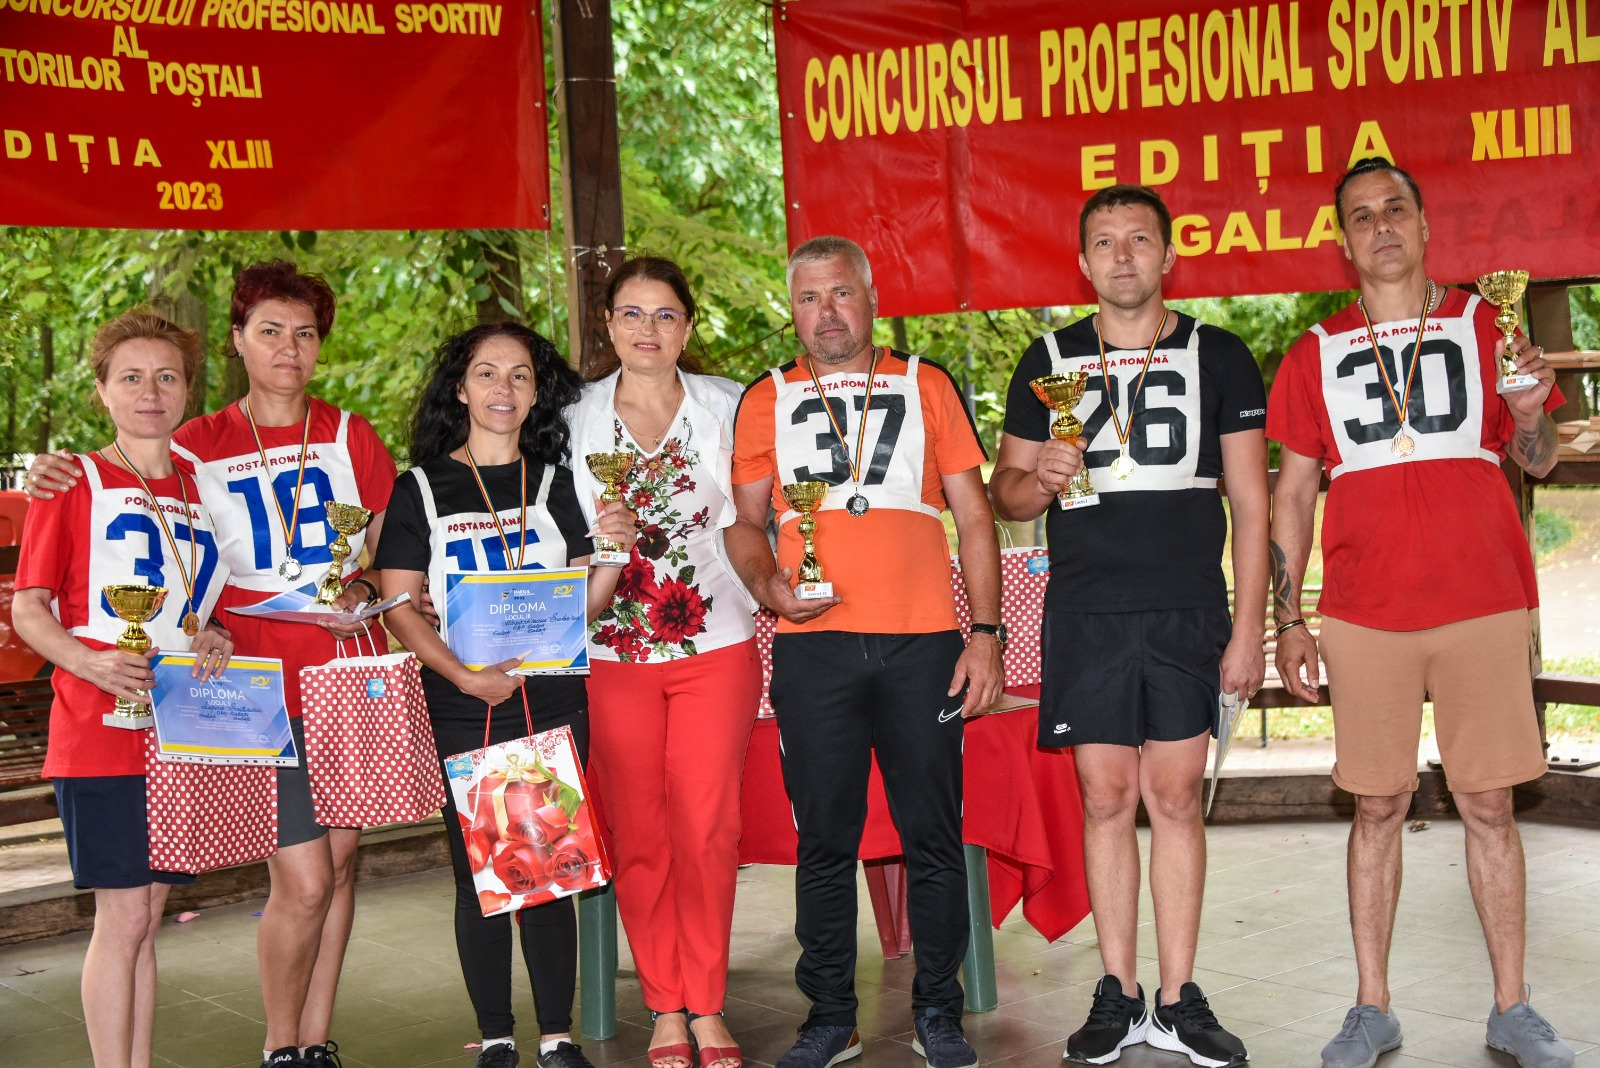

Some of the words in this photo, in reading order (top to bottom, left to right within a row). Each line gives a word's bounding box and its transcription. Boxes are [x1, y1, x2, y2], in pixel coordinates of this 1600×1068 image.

[201, 0, 386, 34] PROFESIONAL
[396, 3, 502, 36] SPORTIV
[112, 25, 149, 59] AL
[0, 48, 125, 92] TORILOR
[804, 35, 1022, 143] CONCURSUL
[1040, 1, 1313, 118] PROFESIONAL
[1328, 0, 1512, 90] SPORTIV
[1543, 0, 1600, 67] AL
[1471, 104, 1572, 161] XLIII
[206, 140, 273, 169] XLIII
[157, 181, 223, 211] 2023
[1391, 322, 1443, 336] ROMNĂ
[1119, 354, 1169, 366] ROMNĂ
[840, 379, 889, 389] ROMNĂ
[1336, 339, 1468, 445] 30
[1083, 371, 1187, 469] 26
[791, 394, 907, 486] 37
[227, 466, 340, 571] 18
[101, 513, 218, 628] 37
[489, 602, 547, 615] DIPLOMA
[189, 687, 246, 700] DIPLOMA
